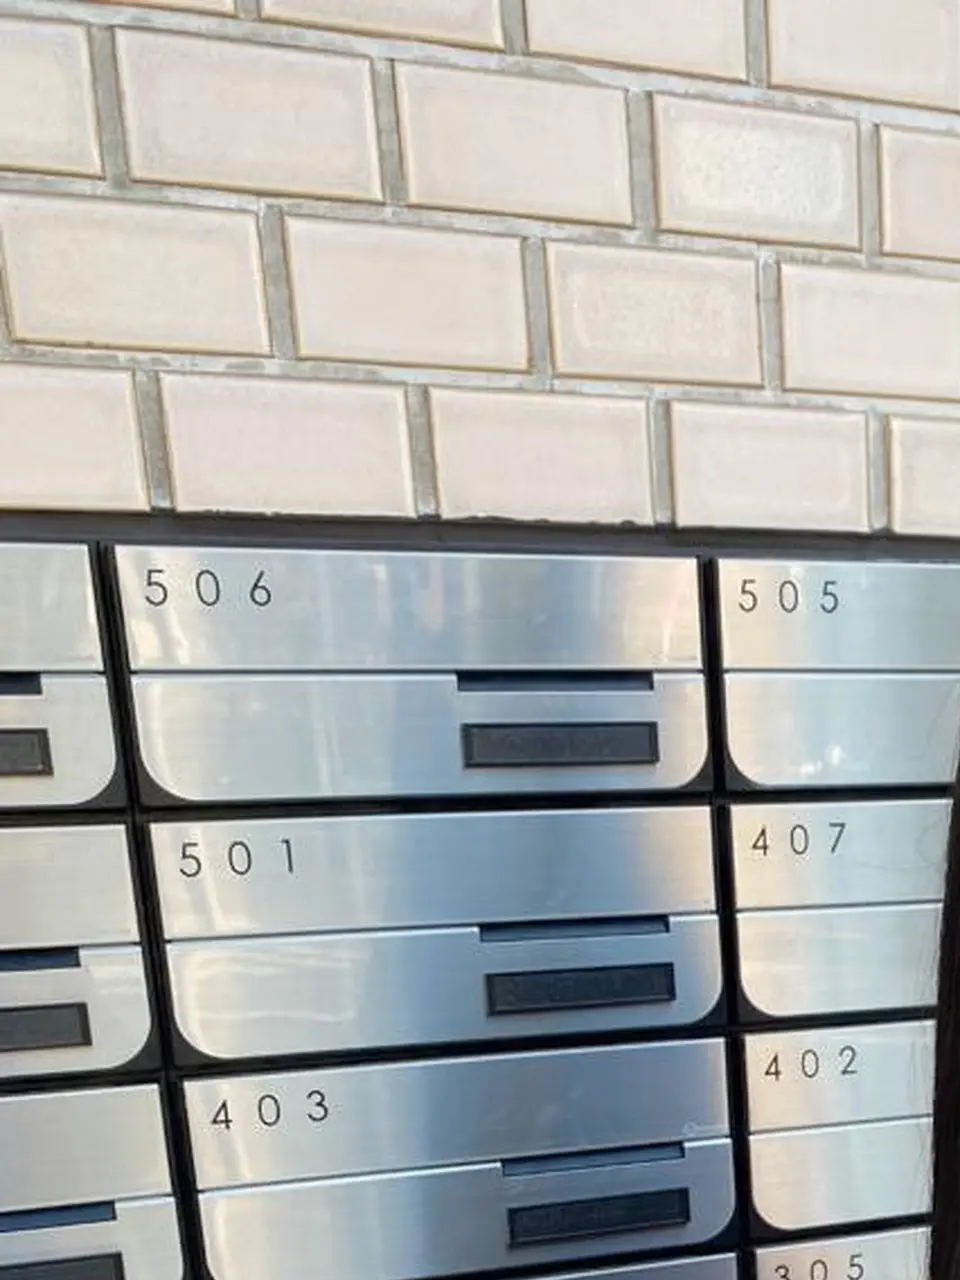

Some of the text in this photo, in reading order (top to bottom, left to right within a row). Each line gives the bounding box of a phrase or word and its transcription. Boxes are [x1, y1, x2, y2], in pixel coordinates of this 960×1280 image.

[144, 568, 272, 608] 506
[738, 578, 840, 615] 505
[178, 838, 295, 879] 501
[751, 821, 847, 857] 407
[763, 1044, 858, 1082] 402
[210, 1089, 330, 1131] 403
